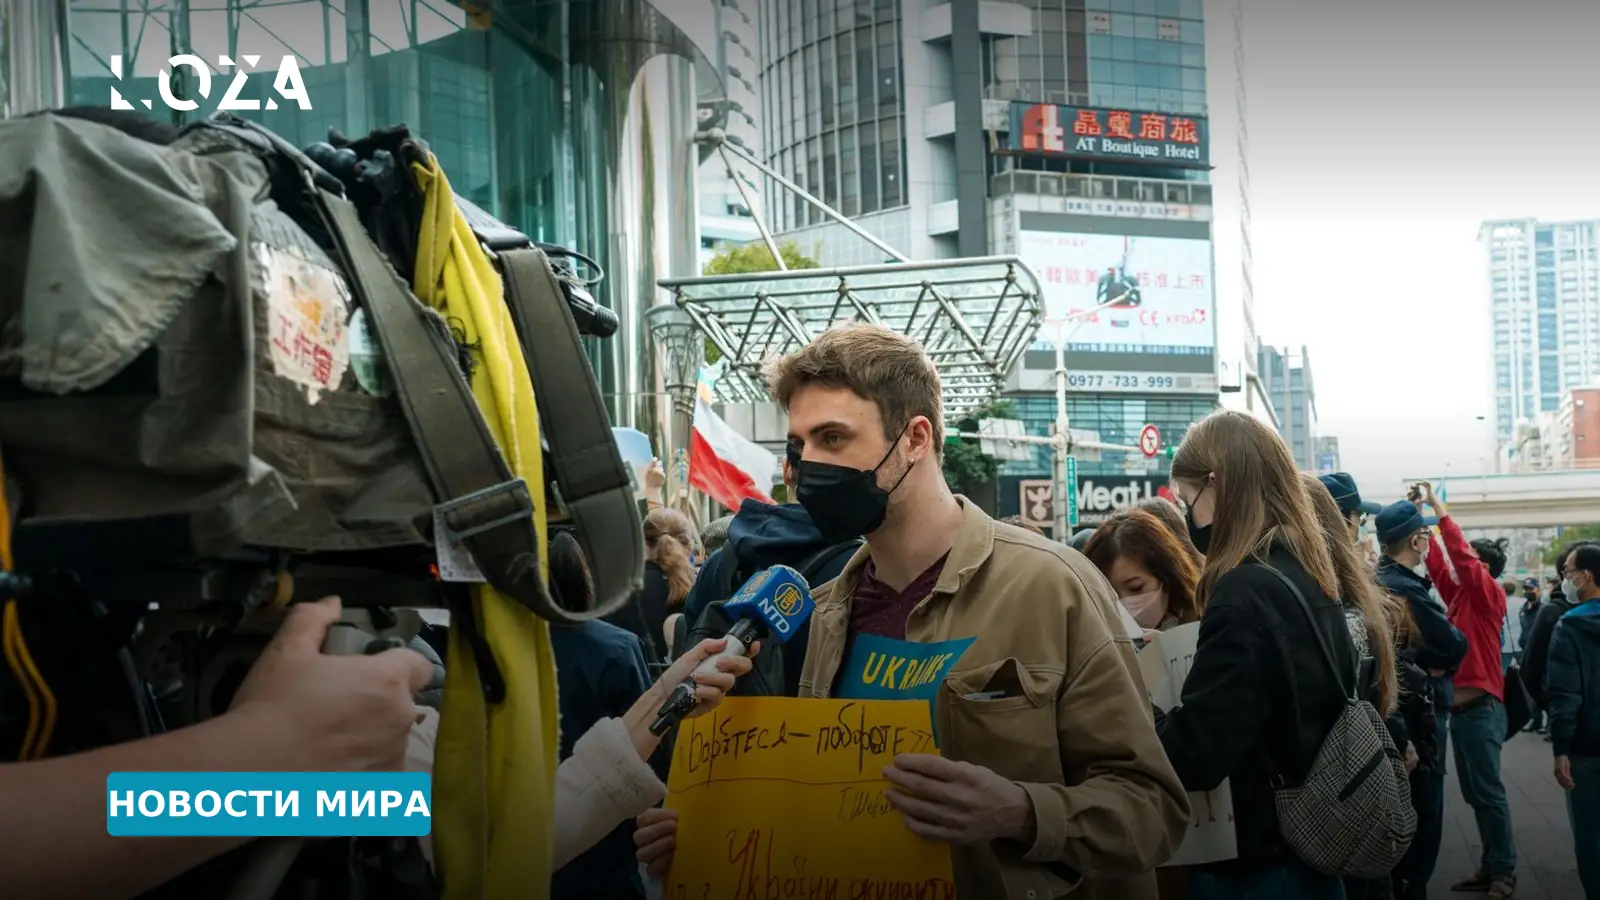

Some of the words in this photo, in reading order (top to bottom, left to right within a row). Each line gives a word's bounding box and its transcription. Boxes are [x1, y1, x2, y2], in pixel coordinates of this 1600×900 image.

[1075, 136, 1097, 150] AT
[1103, 139, 1160, 158] Boutique
[1165, 144, 1200, 159] Hotel
[1077, 480, 1141, 511] Meat
[757, 597, 790, 633] NTD
[862, 651, 953, 690] UKRAINE
